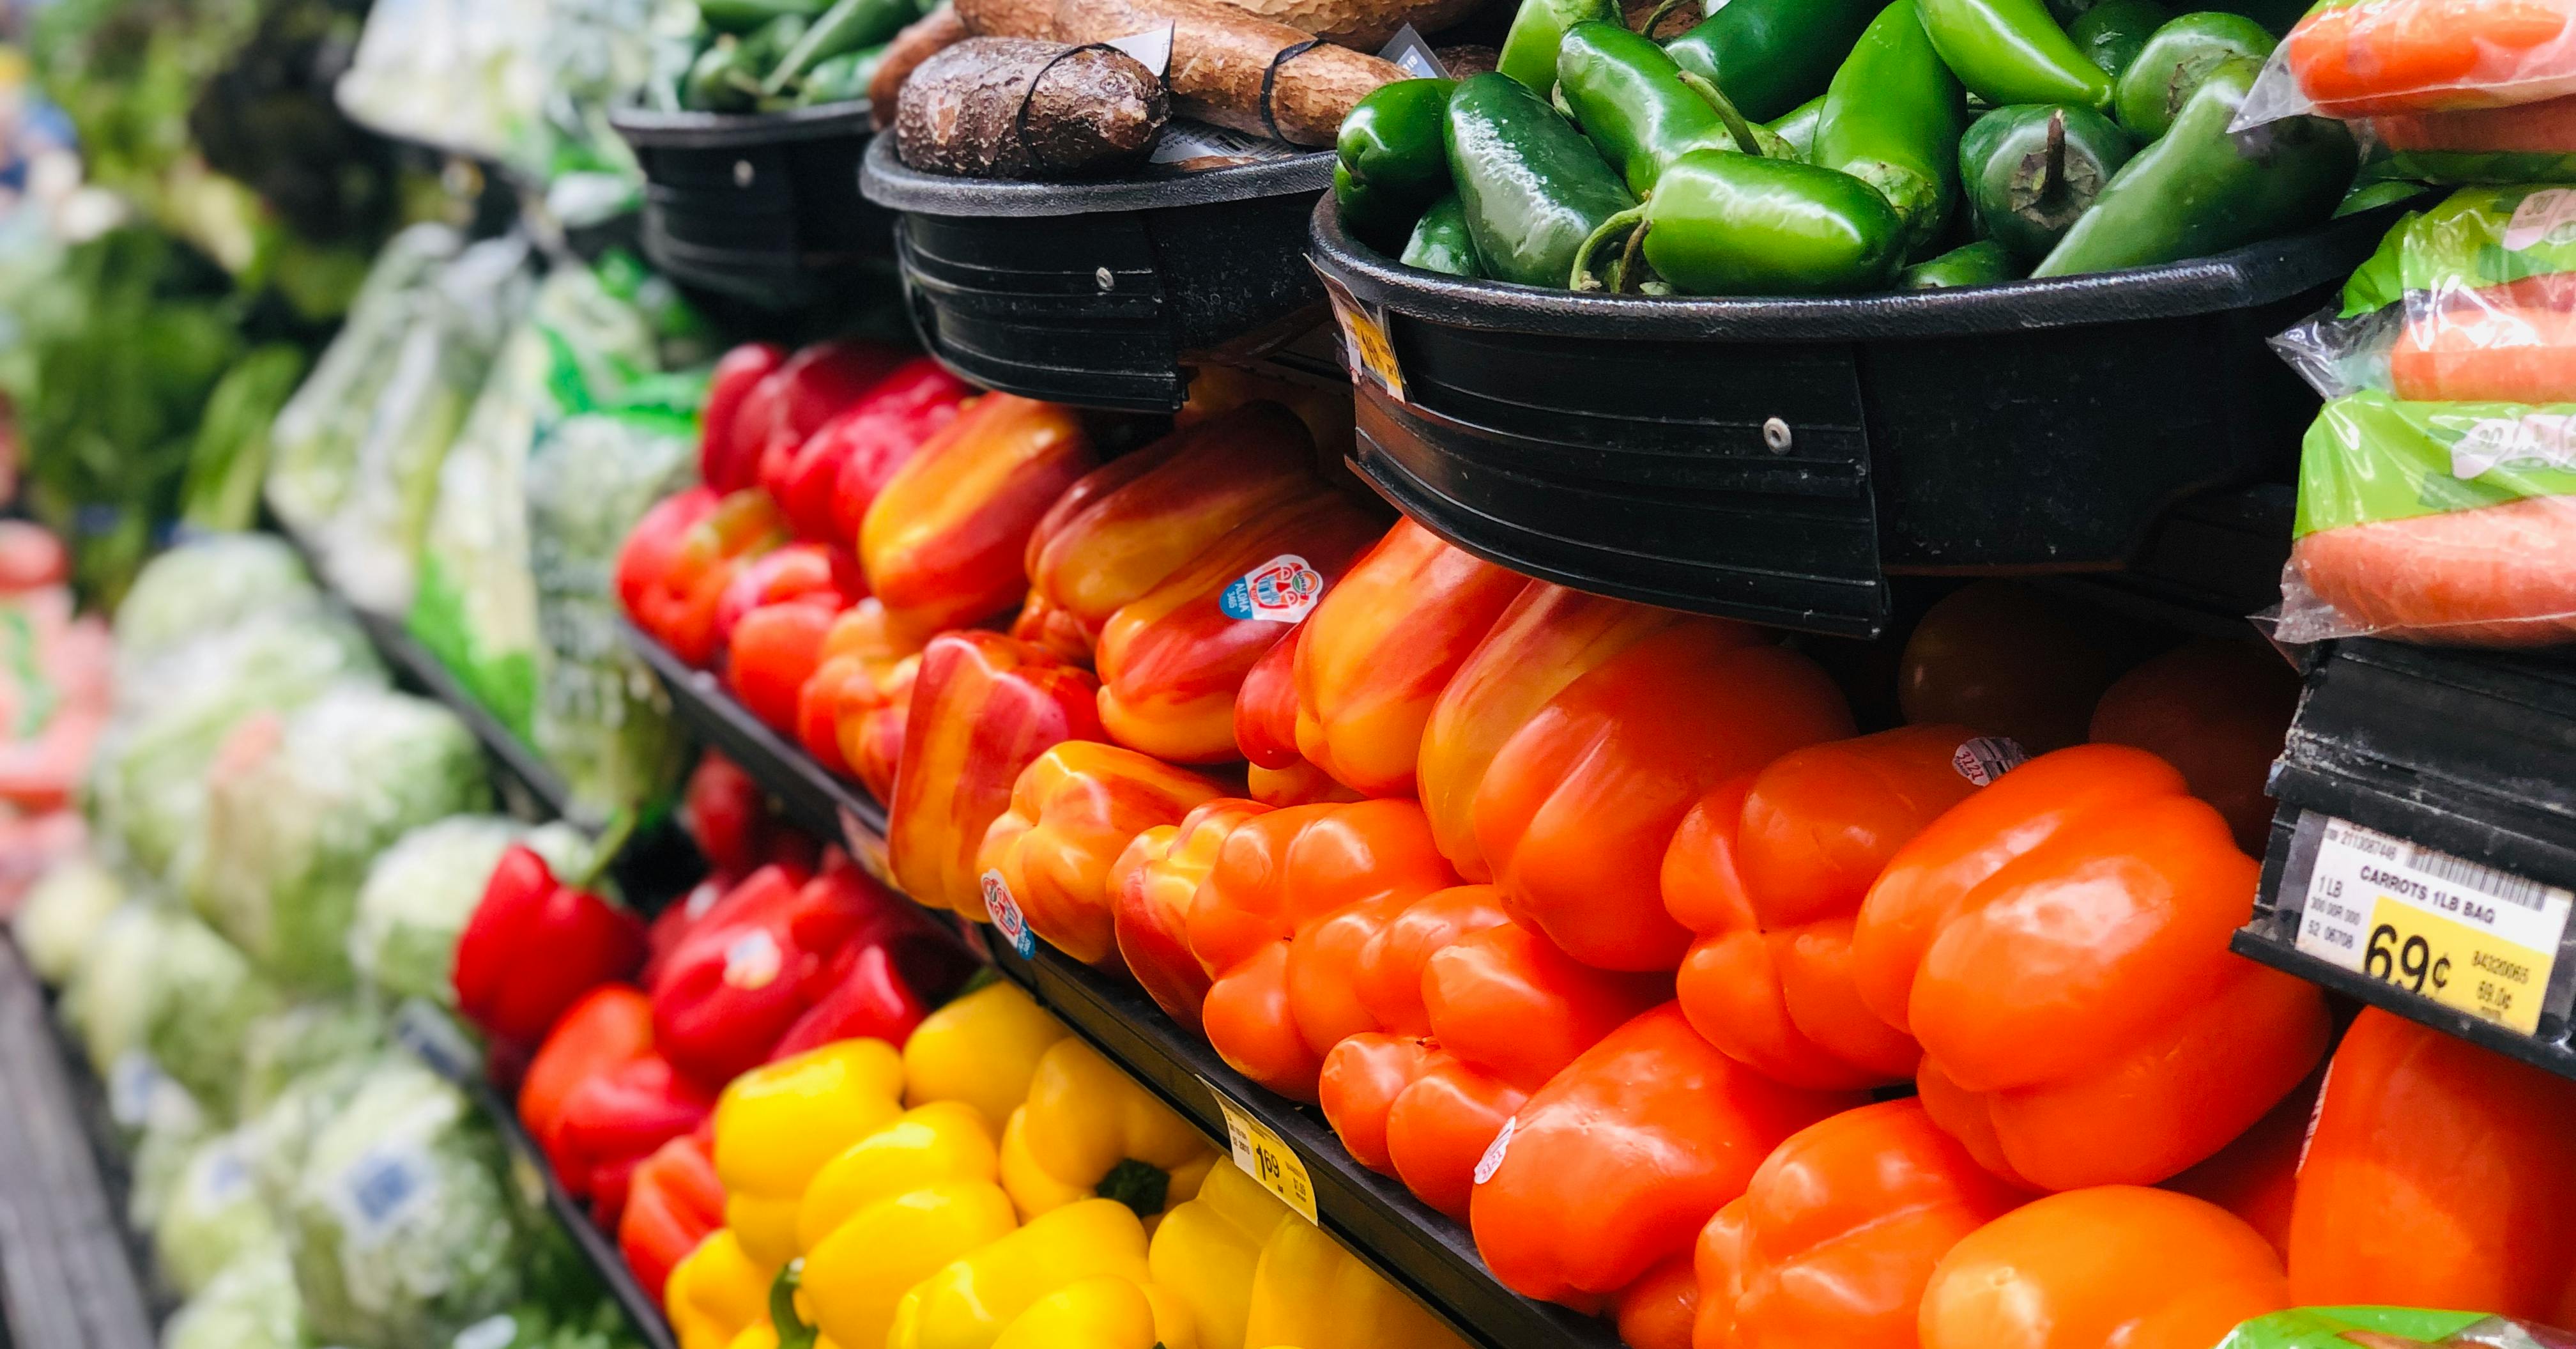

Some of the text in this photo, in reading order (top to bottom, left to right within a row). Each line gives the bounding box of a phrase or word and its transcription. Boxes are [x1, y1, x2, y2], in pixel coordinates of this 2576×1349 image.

[1235, 583, 1250, 613] ALOHA
[1296, 571, 1308, 598] SUNSET
[1956, 751, 1984, 780] 3121
[2319, 875, 2343, 898] 1 LB
[2360, 865, 2495, 924] CARROTS 1LB BAG
